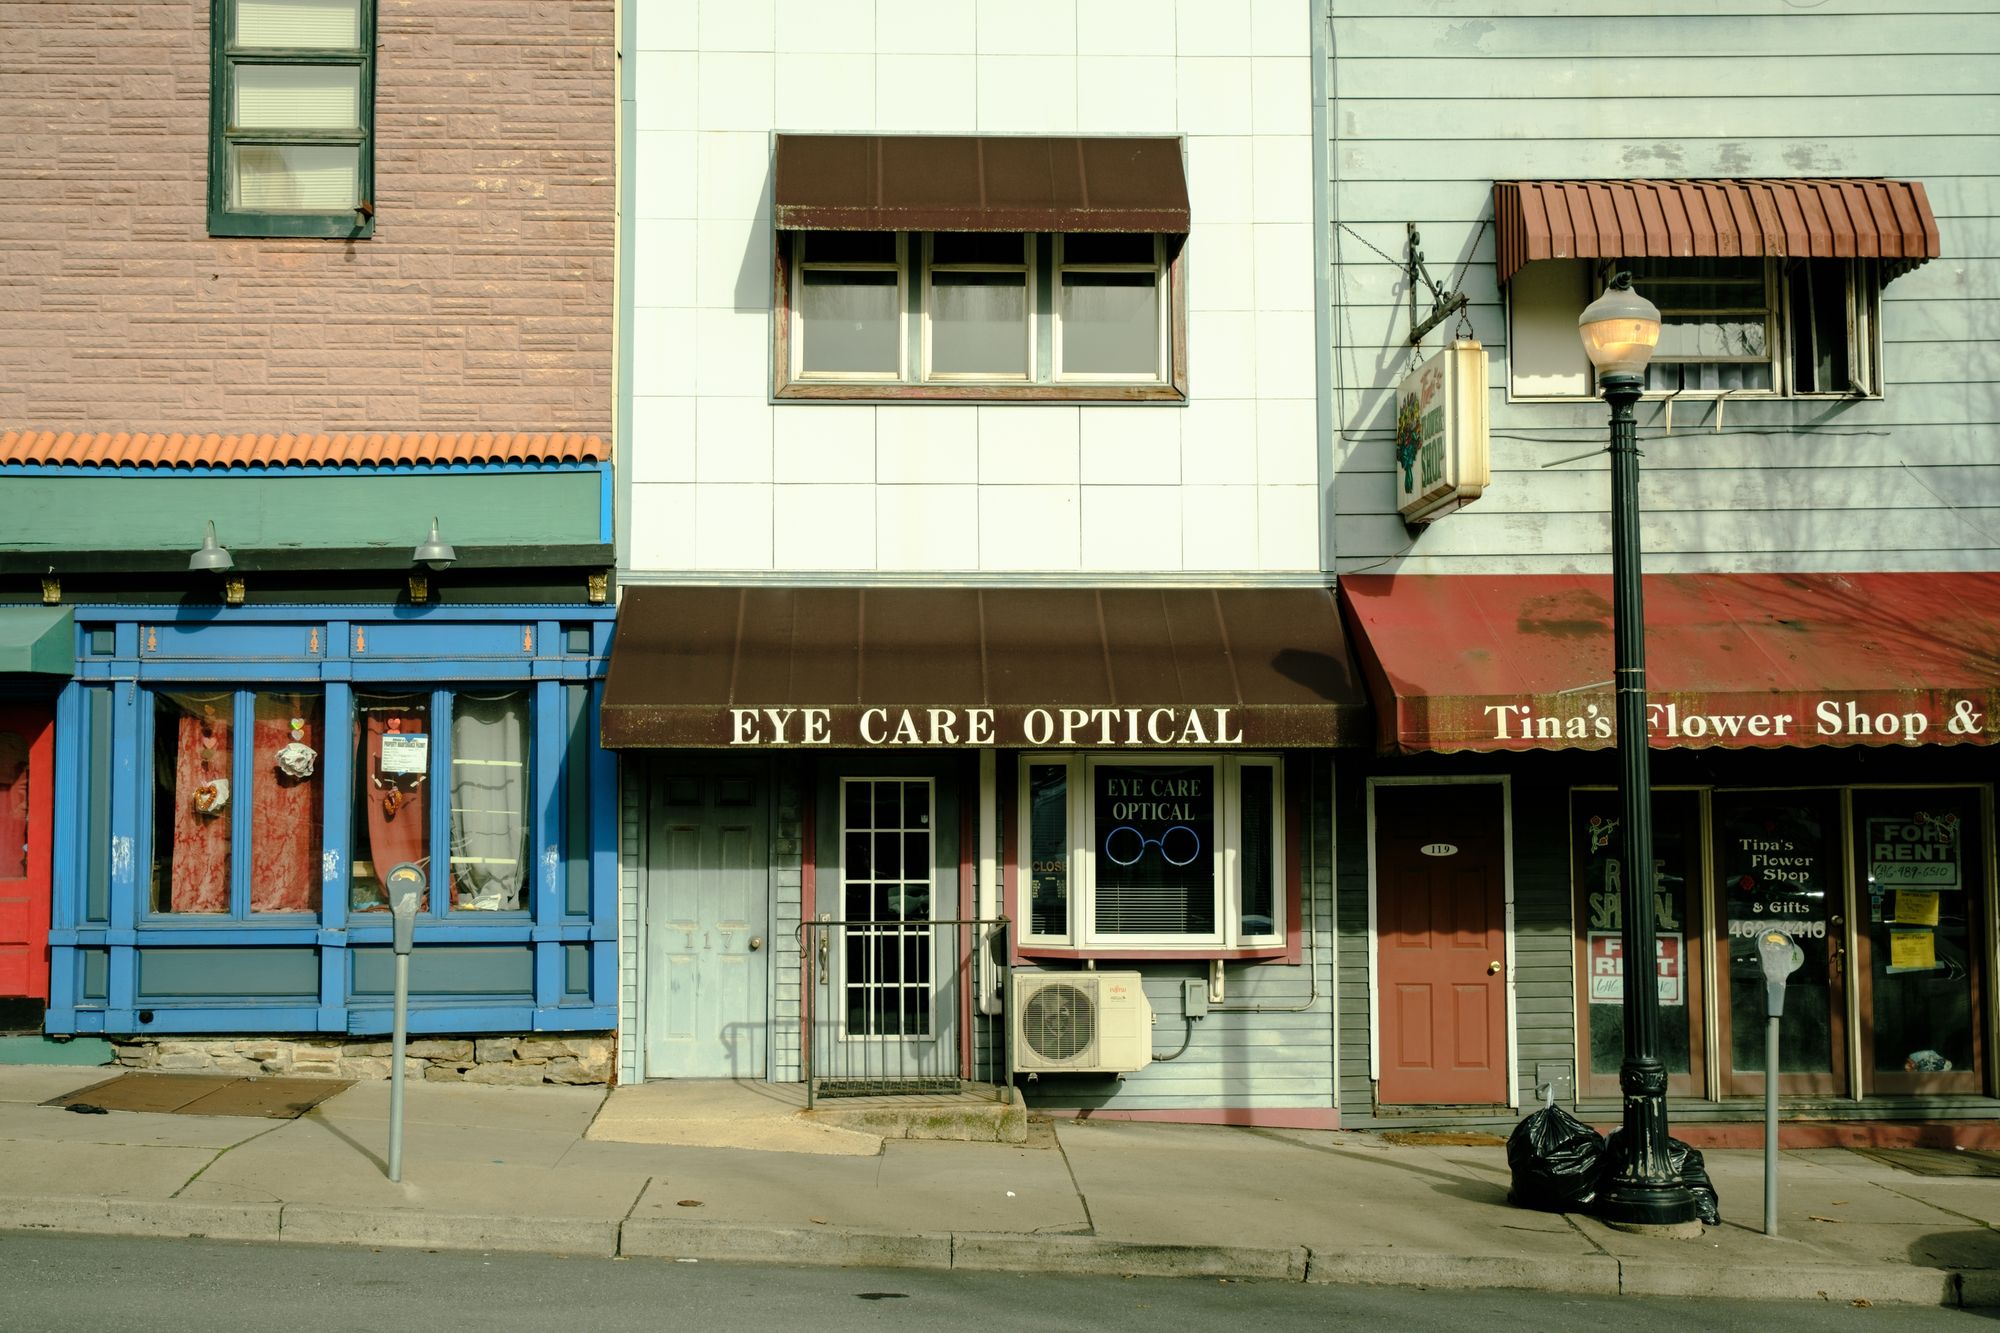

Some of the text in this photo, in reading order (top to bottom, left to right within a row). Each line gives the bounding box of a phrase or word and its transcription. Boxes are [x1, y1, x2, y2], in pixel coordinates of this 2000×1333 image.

[1421, 436, 1444, 488] SHOP
[729, 708, 1243, 745] EYE CARE OPTICAL
[1484, 704, 1612, 739] Tina's
[1816, 701, 1928, 740] Shop
[1948, 700, 1983, 735] &
[1108, 779, 1202, 797] EYE CARE
[1113, 802, 1195, 820] OPTICAL
[1884, 825, 1941, 842] FOR
[1432, 845, 1450, 854] 119
[1739, 839, 1794, 851] Tina's
[1875, 843, 1949, 860] RENT
[1752, 855, 1814, 867] Flower
[1763, 869, 1809, 883] Shop
[1752, 902, 1810, 913] & Gifts
[685, 930, 732, 950] 117
[1595, 957, 1674, 975] RT
